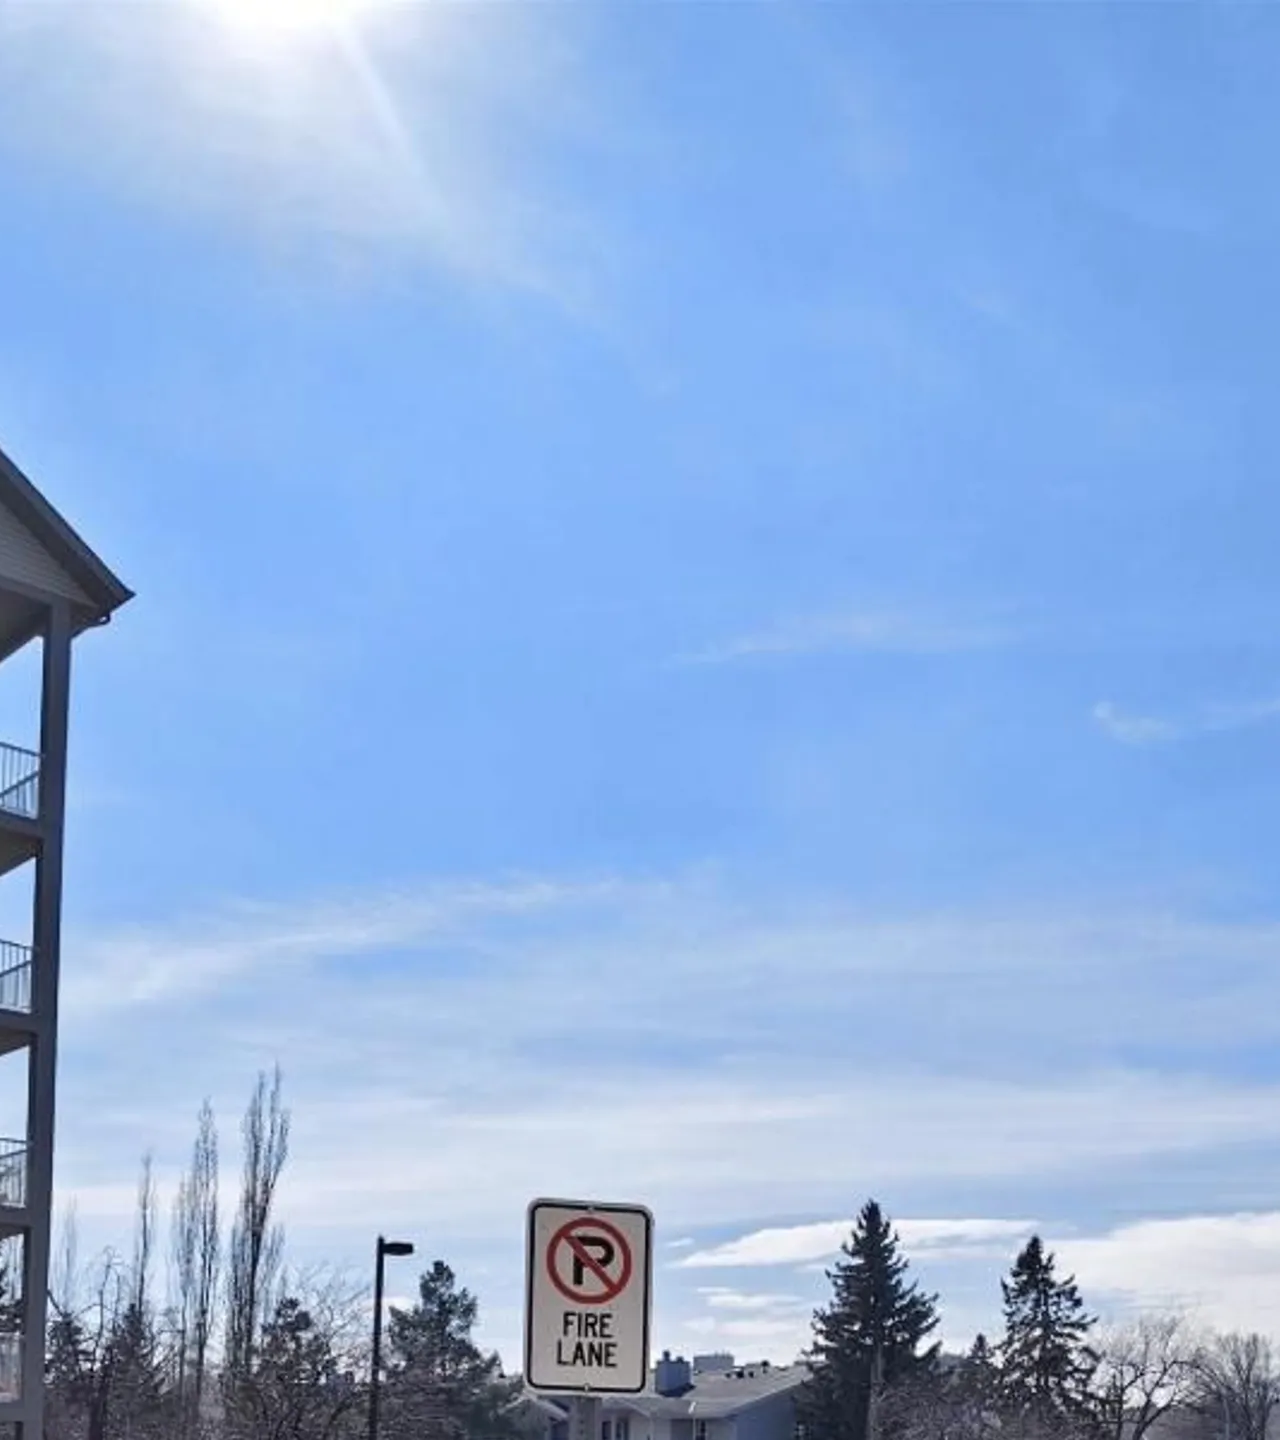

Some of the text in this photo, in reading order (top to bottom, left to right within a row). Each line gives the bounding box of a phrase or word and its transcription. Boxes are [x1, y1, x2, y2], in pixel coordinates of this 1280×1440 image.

[571, 1237, 615, 1286] P
[563, 1312, 614, 1338] FIRE
[557, 1340, 618, 1368] LANE
